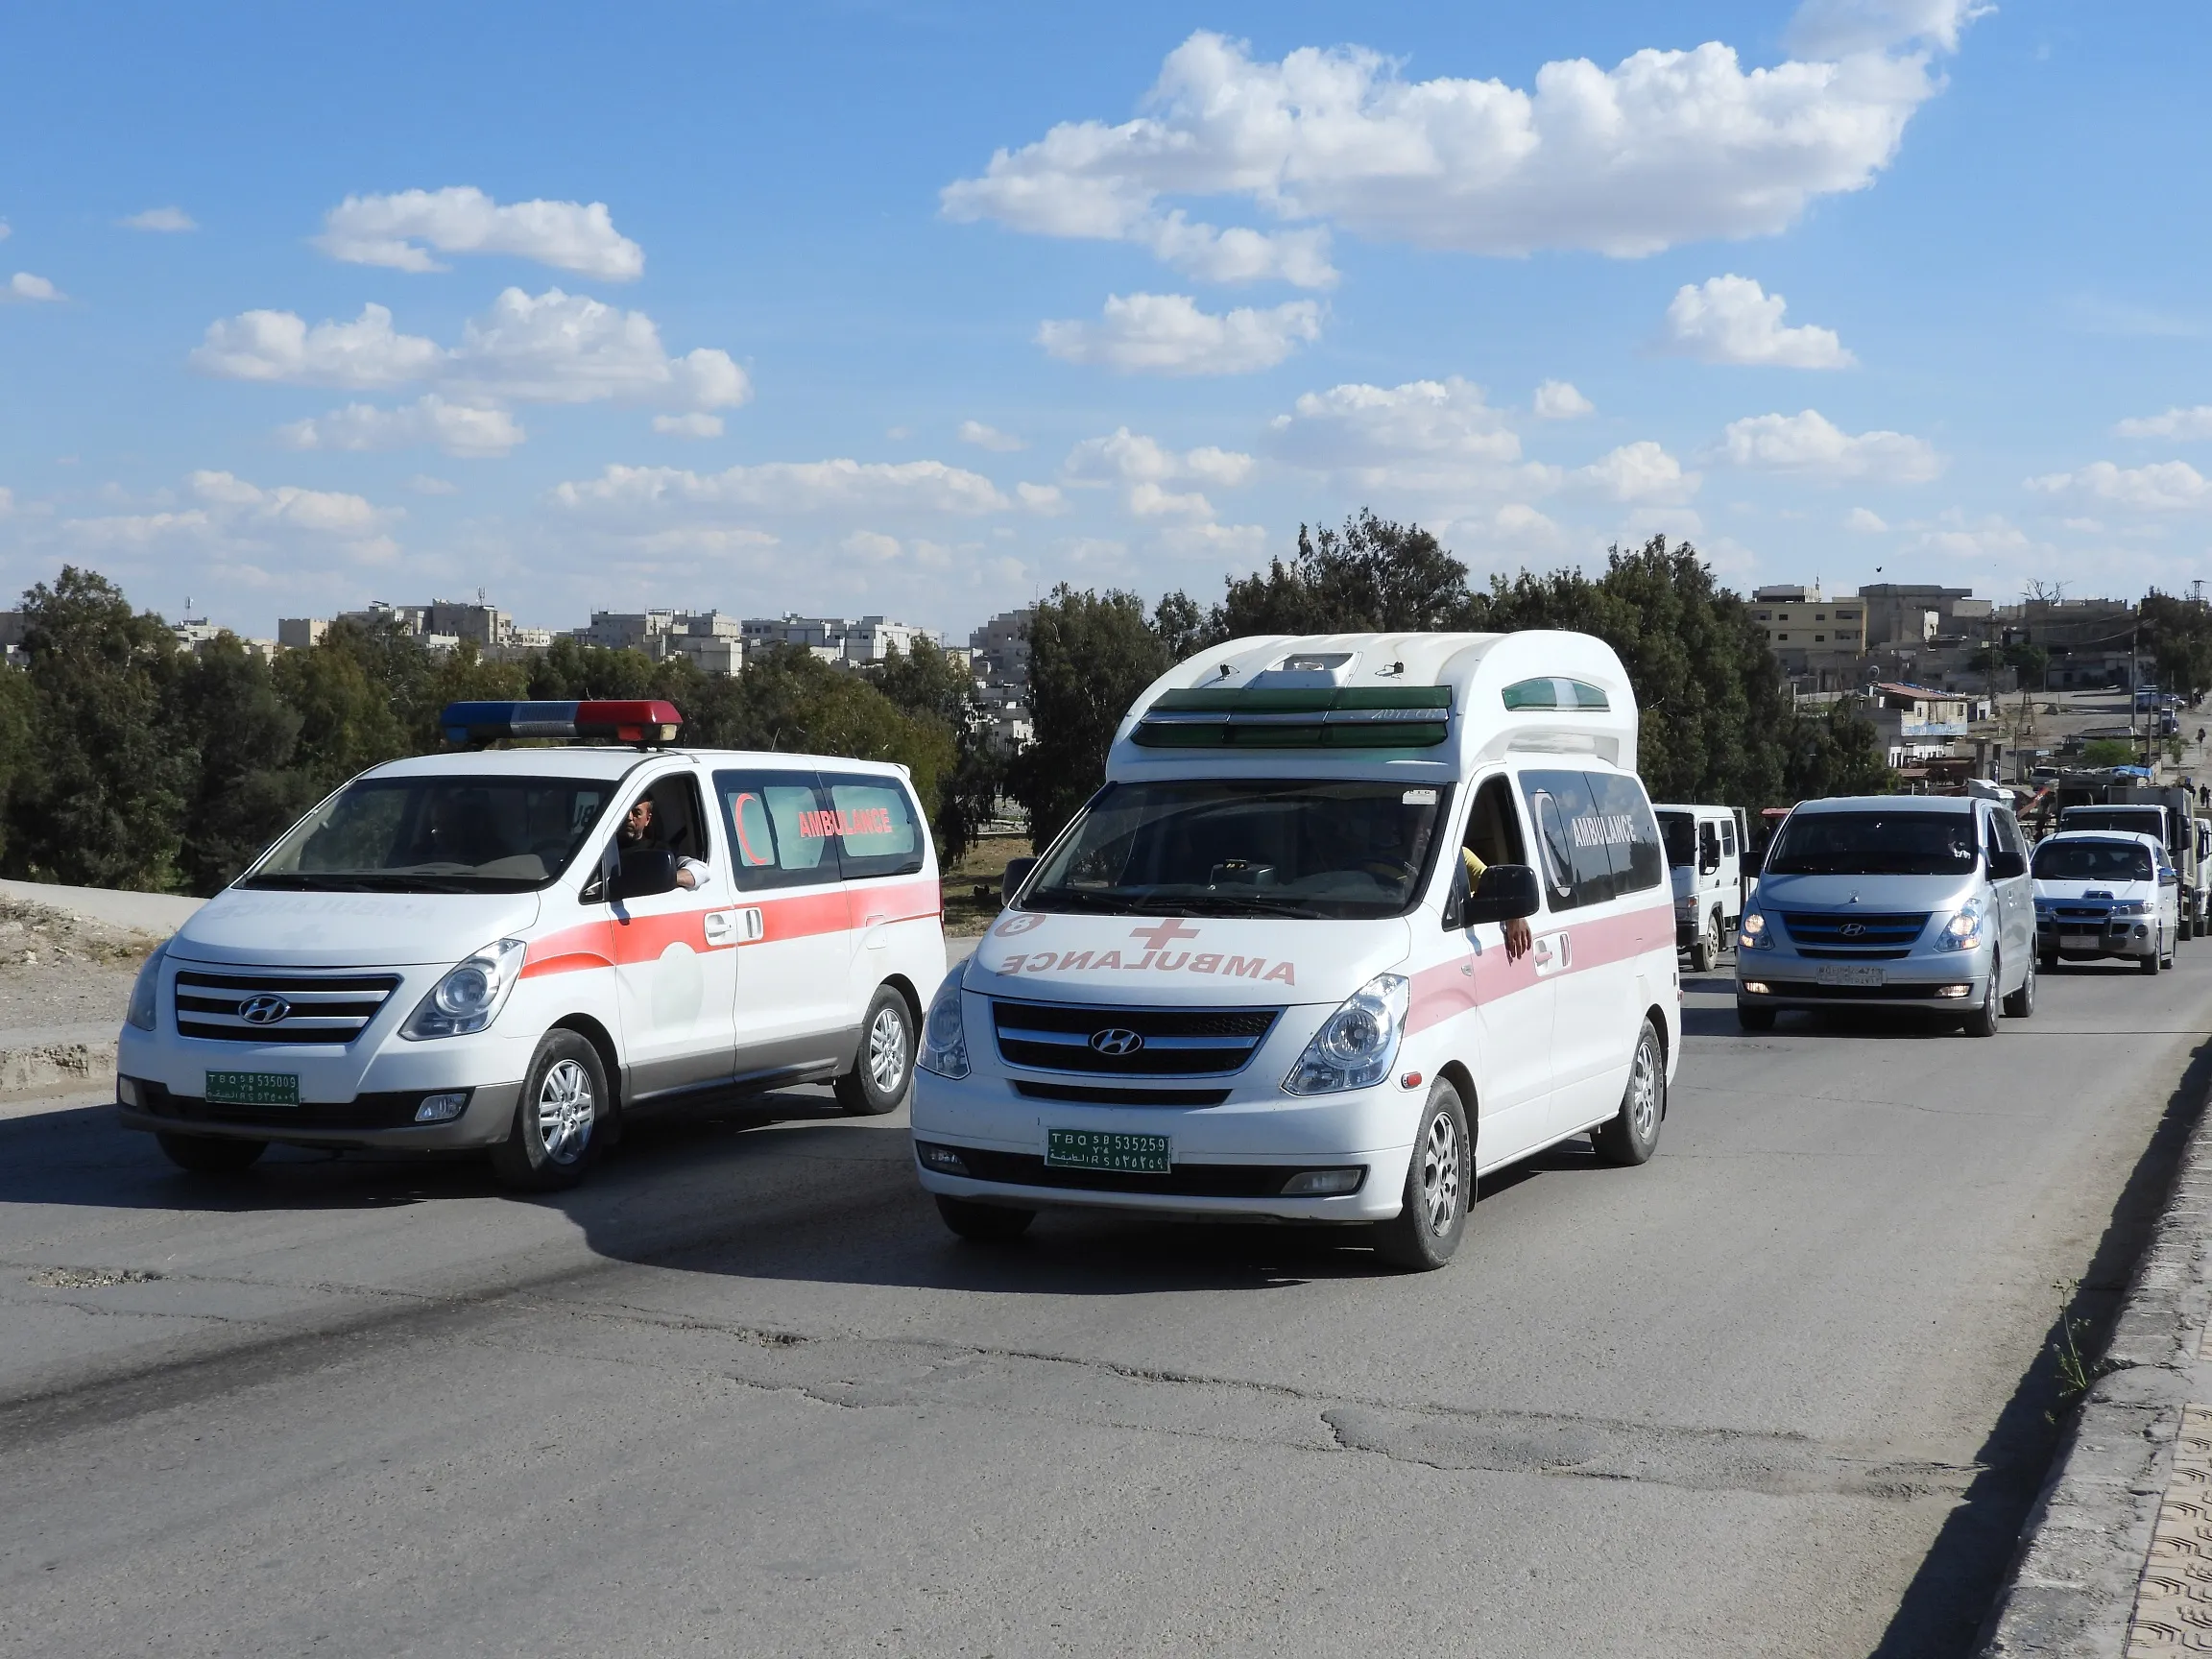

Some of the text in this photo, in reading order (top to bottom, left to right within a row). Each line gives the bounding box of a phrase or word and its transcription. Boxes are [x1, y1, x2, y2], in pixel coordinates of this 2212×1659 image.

[798, 807, 893, 838] AMBULANCE
[1571, 814, 1637, 848] AMBULANCE
[257, 1075, 296, 1088] 535009
[1115, 1136, 1165, 1152] 535259
[1115, 1155, 1164, 1169] ٥٣٥٢٥٩
